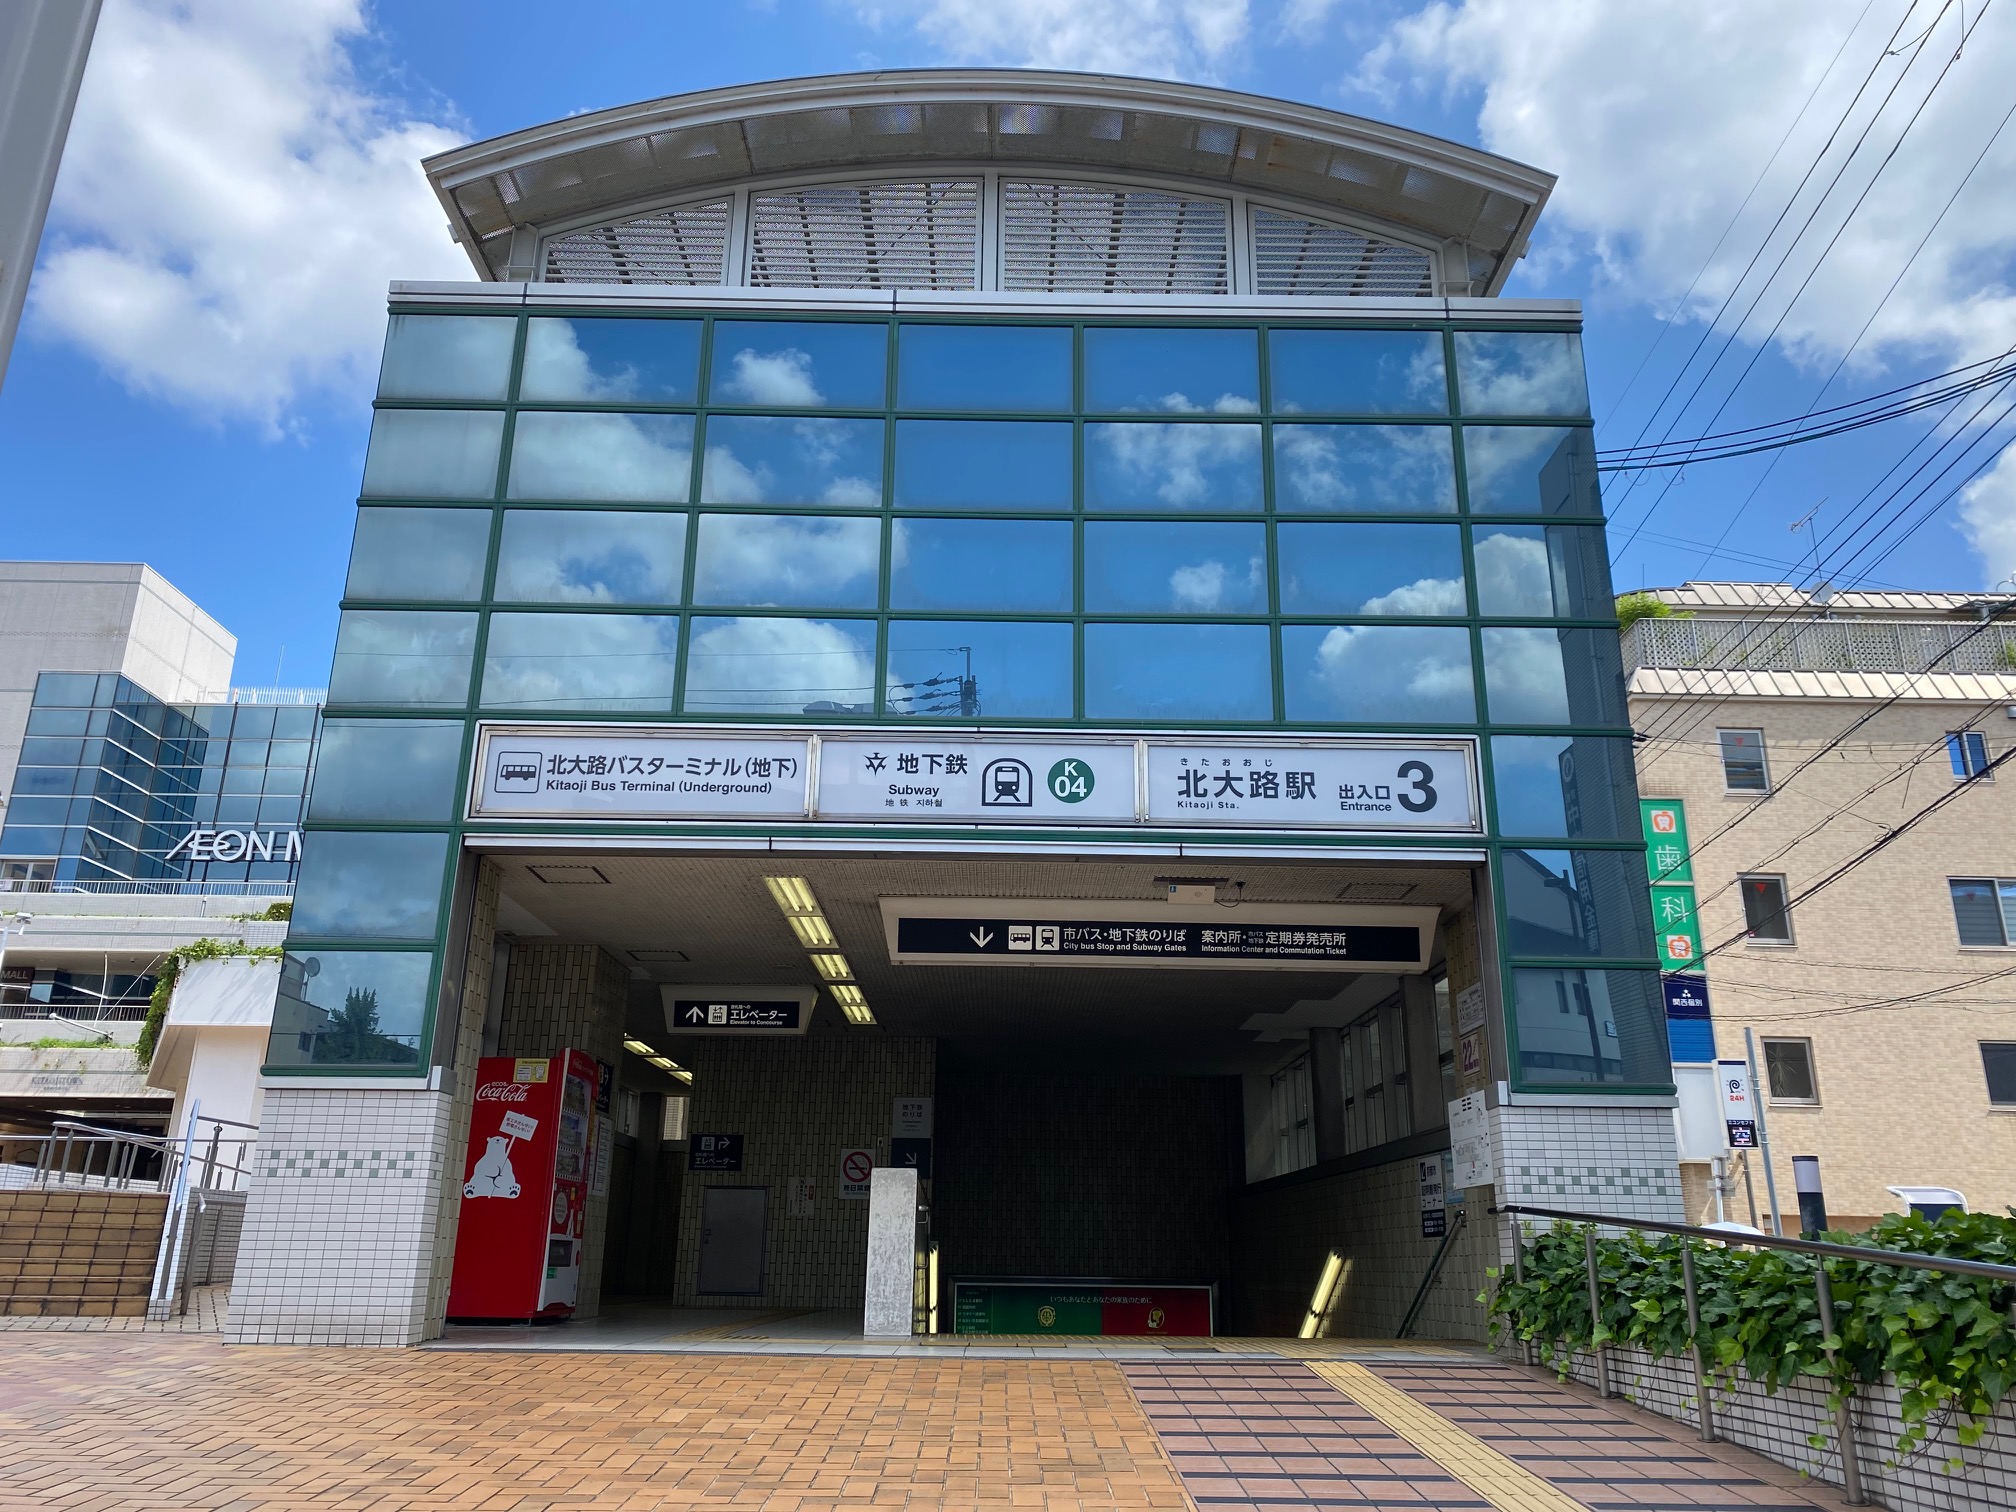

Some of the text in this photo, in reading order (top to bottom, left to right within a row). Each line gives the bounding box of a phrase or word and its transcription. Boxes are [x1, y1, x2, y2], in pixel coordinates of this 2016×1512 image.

[546, 754, 798, 779] 北大路バスターミナル(地下)
[897, 753, 968, 776] 地下鉄
[1064, 761, 1079, 776] K
[546, 780, 772, 795] Kitaoji Bus Terminal (Underground)
[888, 784, 940, 798] Subway
[1054, 776, 1088, 798] 04
[1177, 760, 1438, 813] 北大路駅 出入口 3
[916, 798, 943, 808] 지하철
[1177, 801, 1239, 811] Kitaoji Sta.
[1340, 801, 1392, 812] Entrance
[1063, 942, 1187, 953] City bus Stop and Subway Gates
[1201, 945, 1239, 953] Information
[1241, 945, 1263, 953] Center
[1279, 946, 1324, 955] Commutation
[1326, 946, 1347, 955] Ticket
[730, 1010, 788, 1019] エレベーター
